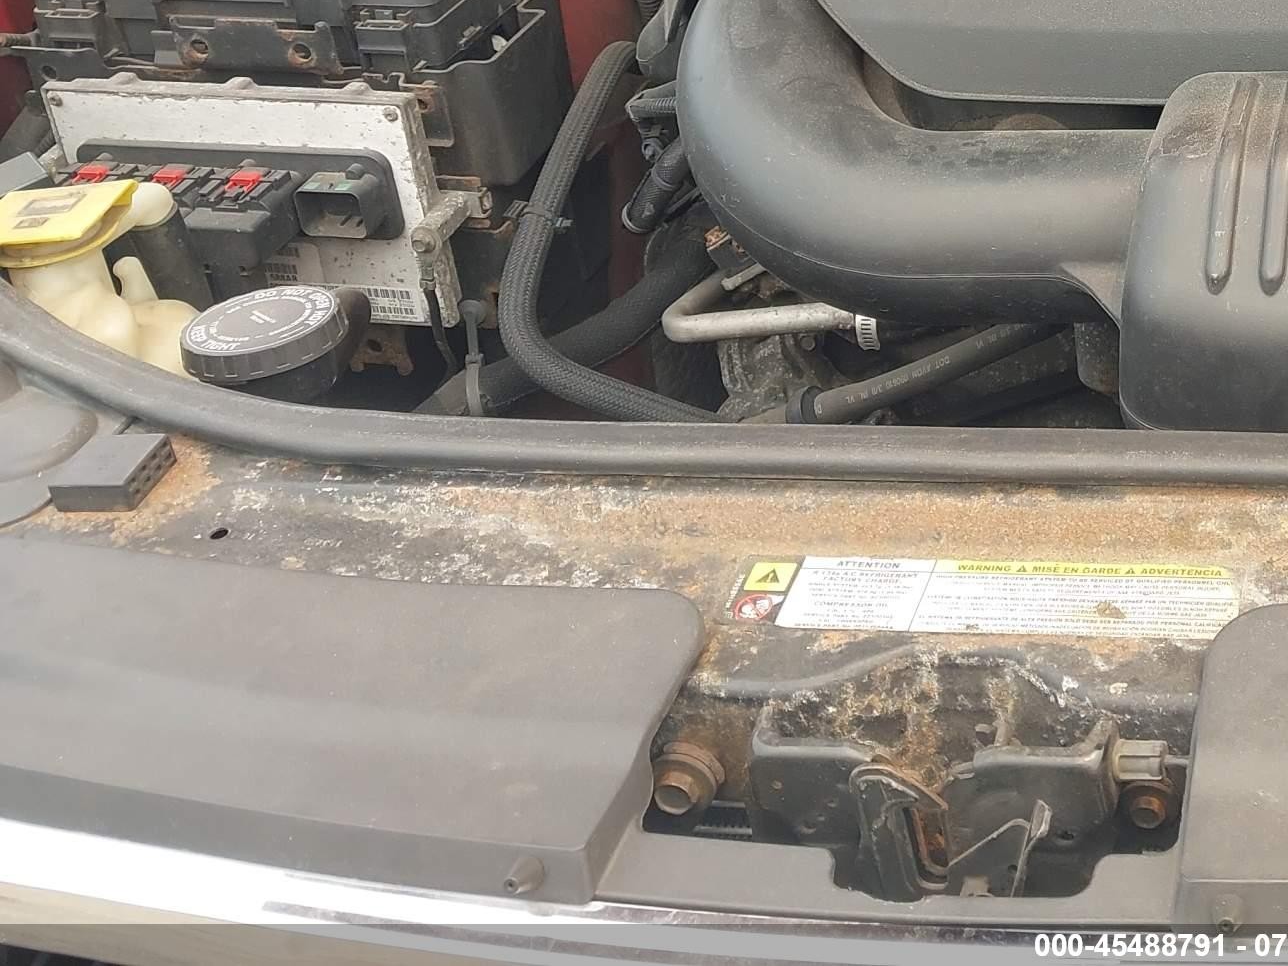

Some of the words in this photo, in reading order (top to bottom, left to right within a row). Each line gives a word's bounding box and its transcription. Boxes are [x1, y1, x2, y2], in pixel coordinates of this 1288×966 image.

[254, 290, 277, 300] DO
[281, 288, 313, 298] NOT
[308, 291, 331, 310] OPEN
[303, 309, 328, 326] HOT
[189, 324, 208, 343] KEEP
[200, 340, 241, 351] TIGHT
[836, 560, 901, 570] ATTENTION
[958, 564, 1012, 573] WARNING
[1064, 566, 1080, 574] EN
[1082, 566, 1121, 575] GARDE
[1140, 567, 1222, 577] ADVERTENCIA
